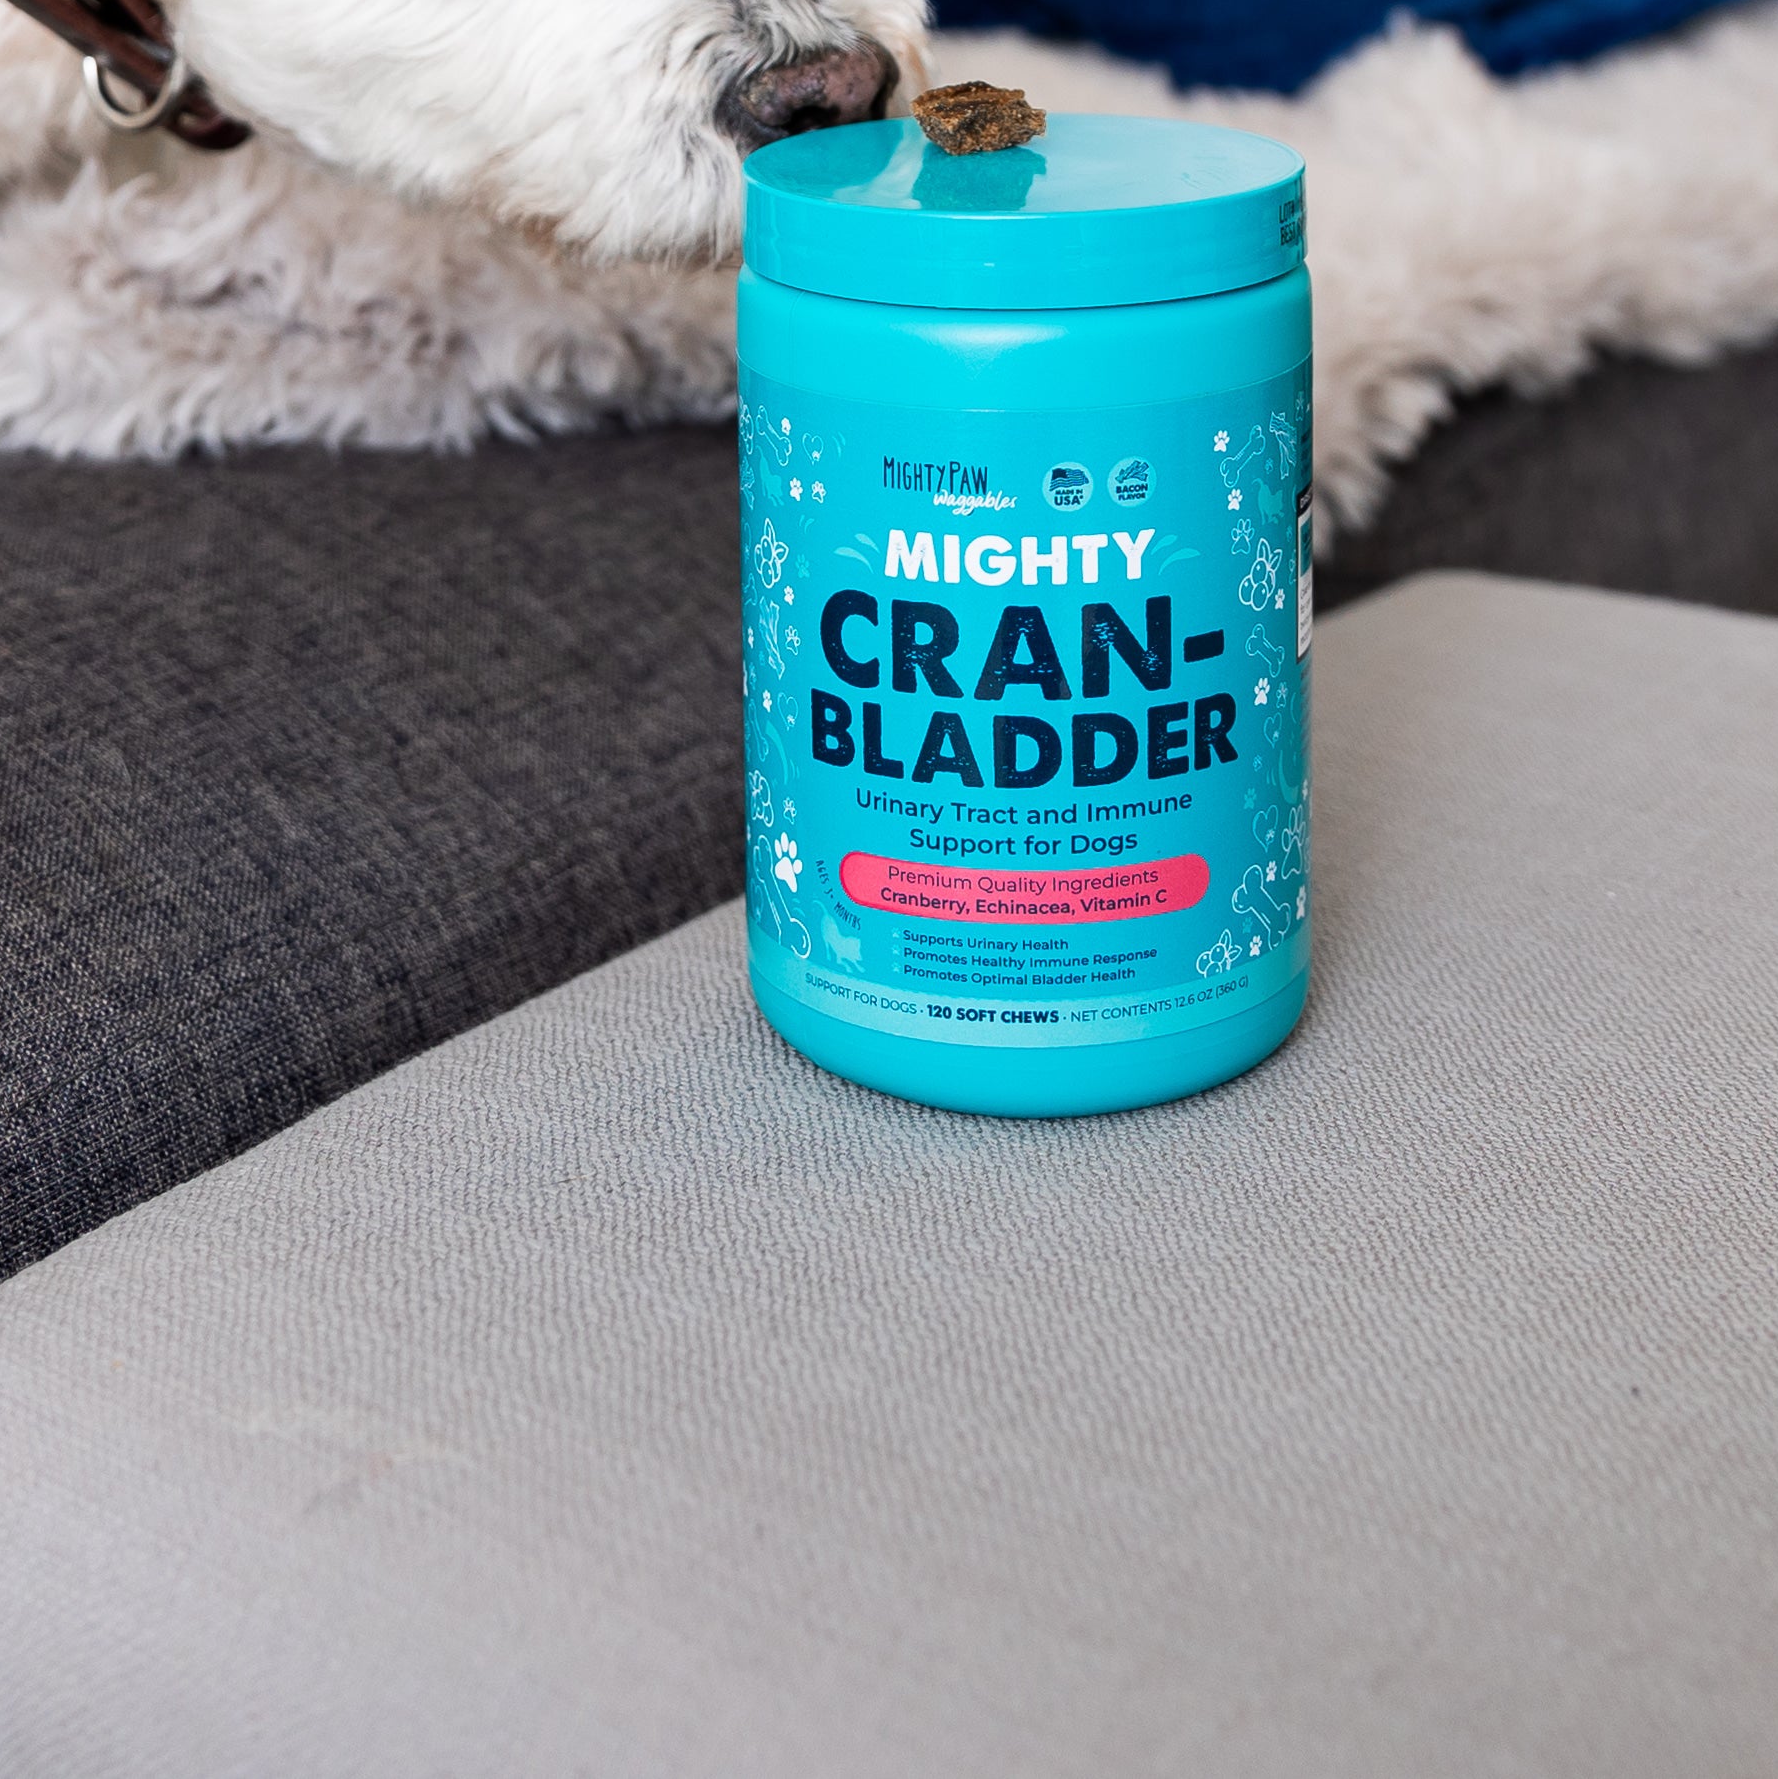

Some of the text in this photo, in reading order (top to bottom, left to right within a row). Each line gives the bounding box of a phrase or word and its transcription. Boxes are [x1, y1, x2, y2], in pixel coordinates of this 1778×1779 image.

[933, 488, 1018, 516] waggables
[1116, 483, 1148, 494] BACON
[1118, 492, 1146, 501] FLAVOR
[884, 528, 1156, 586] MIGHTY
[820, 589, 1224, 700] CRAN-
[811, 688, 1239, 789] BLADDER
[856, 788, 1193, 824] Urinary Tract and Immune
[910, 829, 1138, 857] Support for Dogs
[888, 866, 1158, 895] Premium Quality Ingredients
[816, 860, 829, 884] AGES
[834, 901, 861, 931] MONTHS
[881, 887, 1168, 916] Cranberry, Echinacea, Vitamin C
[903, 929, 1069, 952] Supports Urinary Health
[904, 947, 1157, 970] Promotes Healthy Immune Response
[904, 964, 1135, 986] Promotes Optimal Bladder Health
[805, 972, 852, 999] SUPPORT
[854, 991, 877, 1007] FOR
[881, 998, 917, 1014] DOGS
[927, 1004, 952, 1019] 120
[956, 1008, 996, 1022] SOFT
[1001, 1010, 1059, 1023] CHEWS
[1071, 1010, 1098, 1022] NET
[1102, 999, 1172, 1020] CONTENTS
[1175, 994, 1195, 1008] 12.6
[1197, 989, 1213, 1002] OZ
